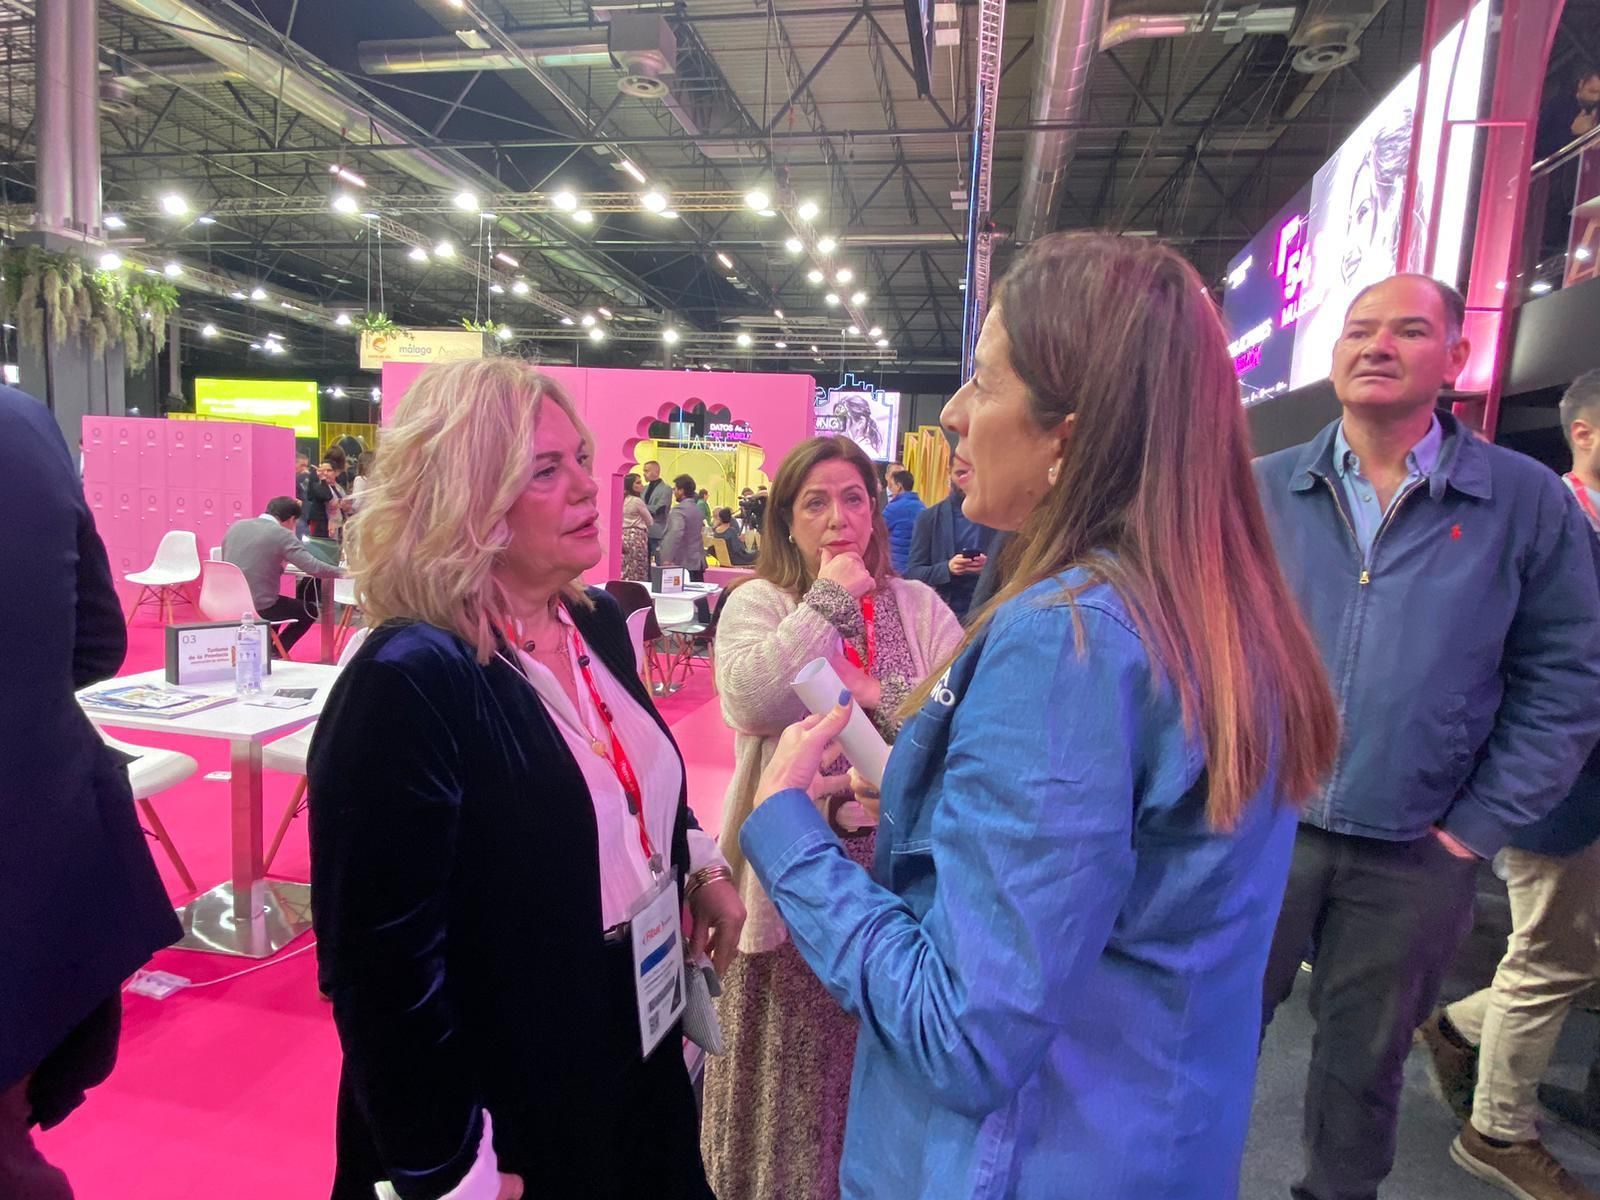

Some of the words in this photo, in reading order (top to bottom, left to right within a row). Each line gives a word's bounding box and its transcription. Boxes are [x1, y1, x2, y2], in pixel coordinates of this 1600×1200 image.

[399, 344, 431, 356] málaga
[709, 423, 734, 432] DATOS
[182, 635, 197, 645] 03
